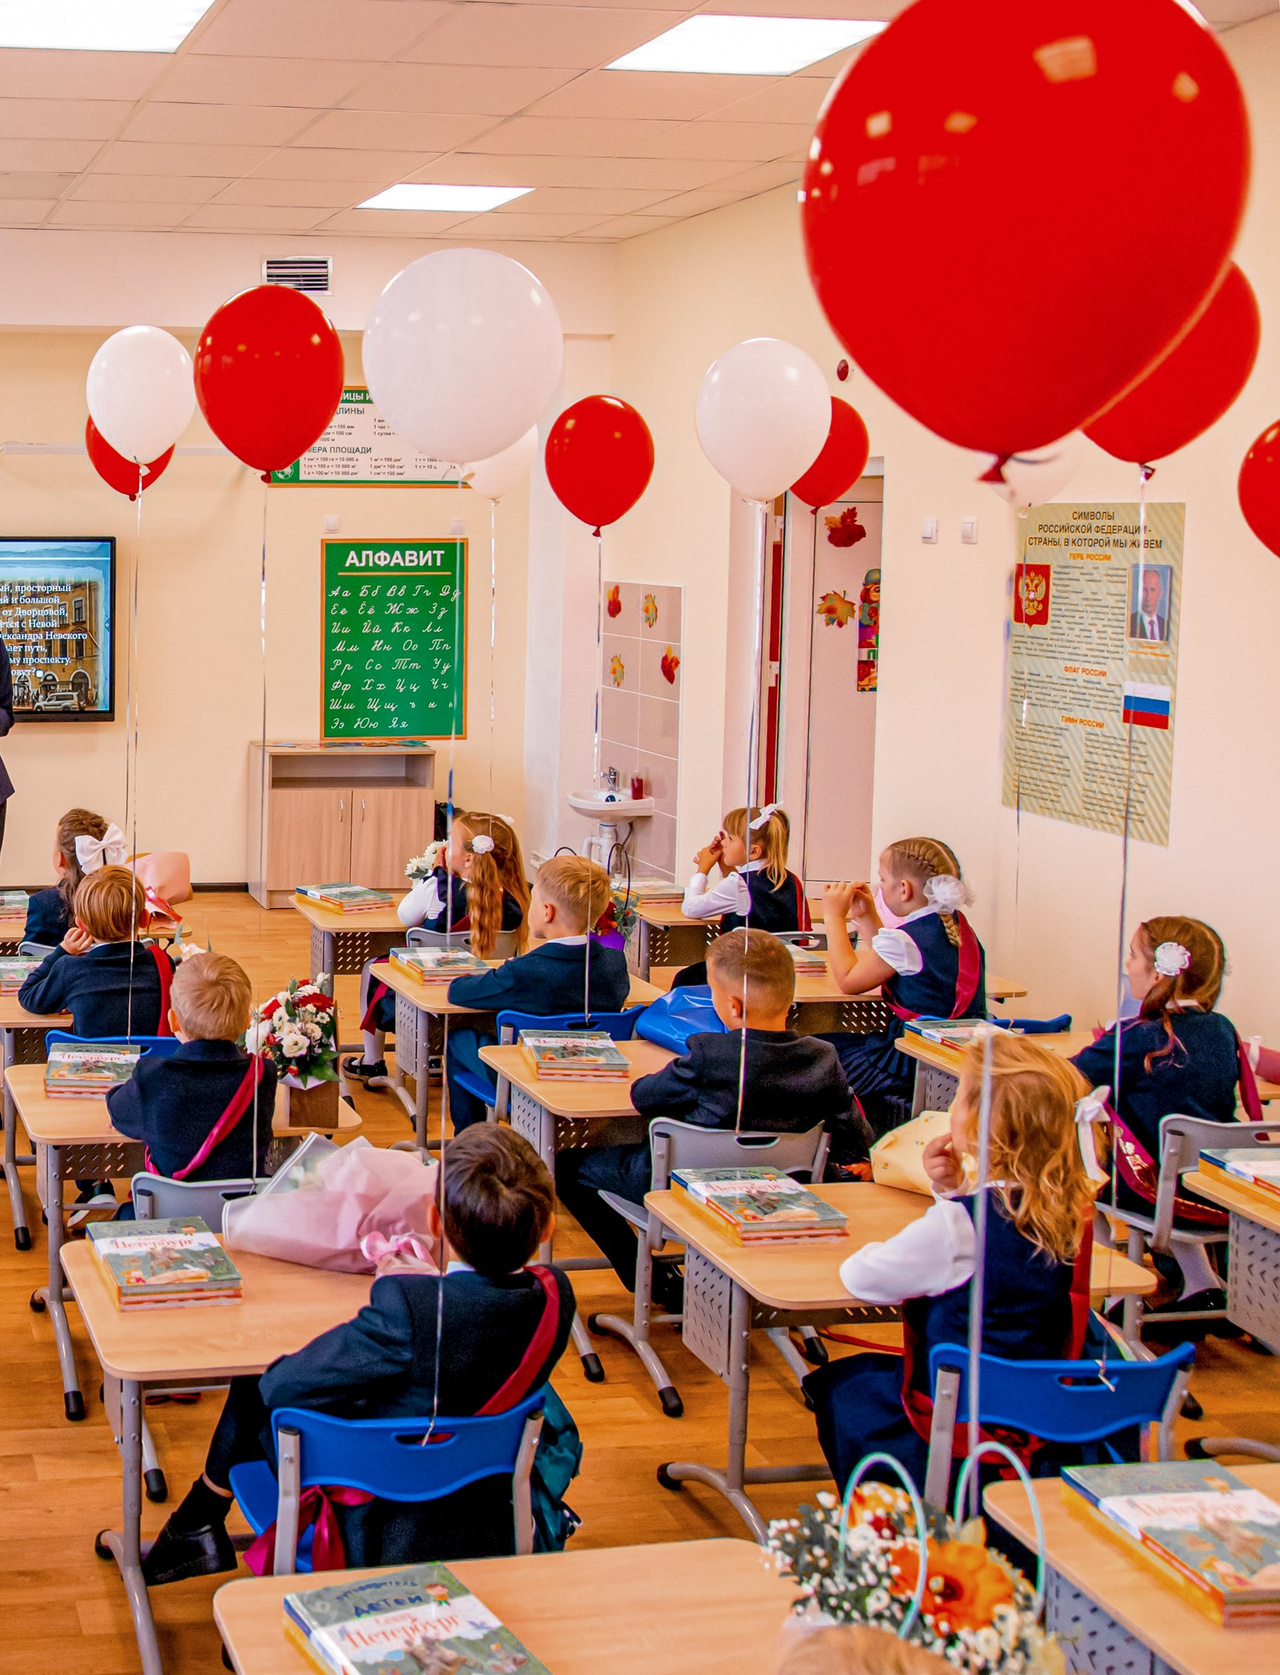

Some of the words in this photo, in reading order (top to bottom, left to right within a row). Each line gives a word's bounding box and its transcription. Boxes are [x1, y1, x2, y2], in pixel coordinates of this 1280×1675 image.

[341, 392, 364, 401] ИЦЫ
[1072, 511, 1114, 520] СИМВОЛЫ
[1038, 523, 1092, 534] РОССИЙСКОЙ
[1064, 538, 1069, 546] В
[1071, 537, 1110, 548] КОТОРОЙ
[1112, 539, 1127, 548] МЫ
[344, 550, 445, 566] АЛФАВИТ
[15, 584, 72, 594] просторный
[14, 608, 68, 617] Дворцовой,
[45, 632, 88, 640] Невского
[25, 646, 47, 654] путь,
[23, 656, 71, 665] проспекту.
[11, 668, 36, 678] овут?
[1064, 666, 1080, 675] ФЛАГ
[1082, 667, 1107, 678] РОССИИ
[1061, 715, 1077, 725] ГИМН
[1079, 718, 1104, 729] РОССИИ
[114, 1238, 194, 1250] Петербург
[344, 1613, 461, 1649] Петербург
